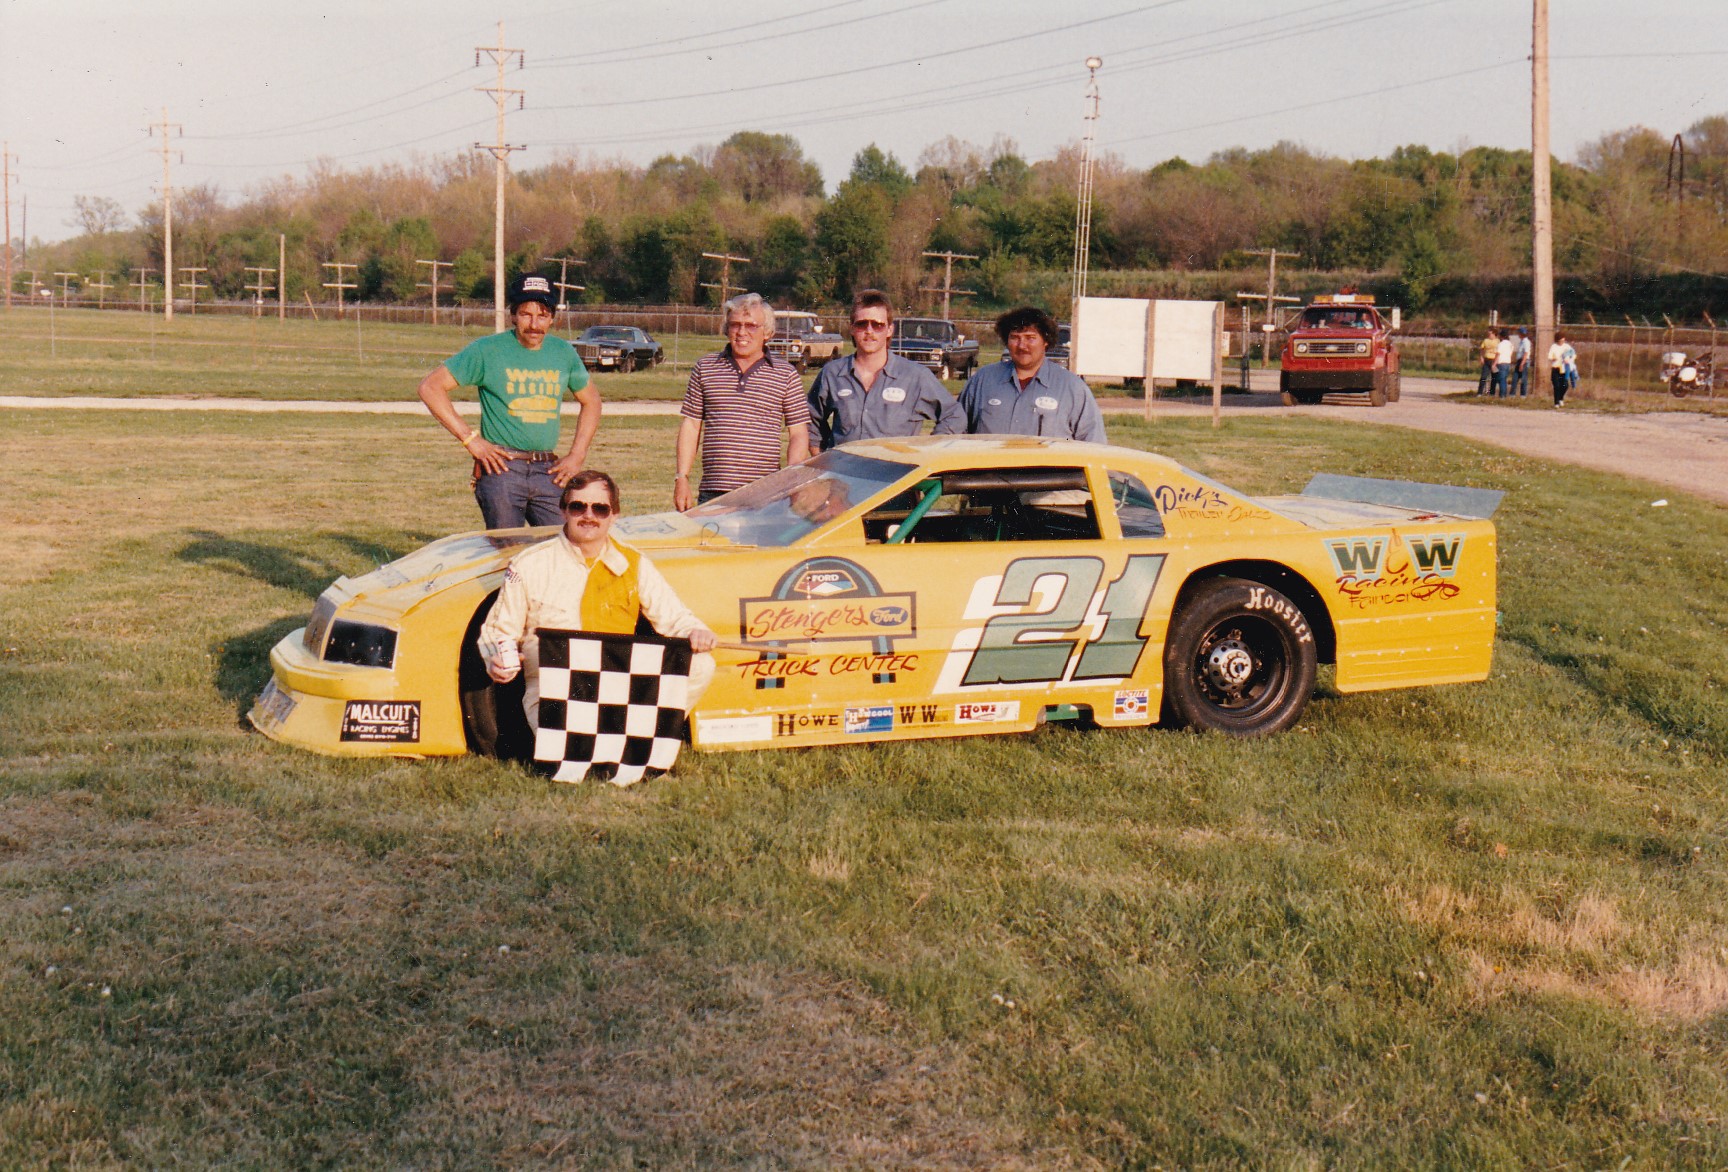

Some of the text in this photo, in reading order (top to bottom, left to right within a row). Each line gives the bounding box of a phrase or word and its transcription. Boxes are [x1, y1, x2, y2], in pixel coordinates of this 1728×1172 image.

[1155, 485, 1228, 514] Dick's
[1327, 538, 1385, 577] W
[1407, 535, 1463, 574] W
[811, 574, 839, 582] FORD
[1336, 573, 1460, 599] Racing
[750, 605, 903, 638] Stengers Ford
[955, 553, 1169, 688] 21
[1244, 588, 1312, 643] Hoosier
[736, 655, 919, 679] TRUCK CENTER
[350, 703, 411, 721] MALCUIT
[777, 714, 839, 736] HOWE
